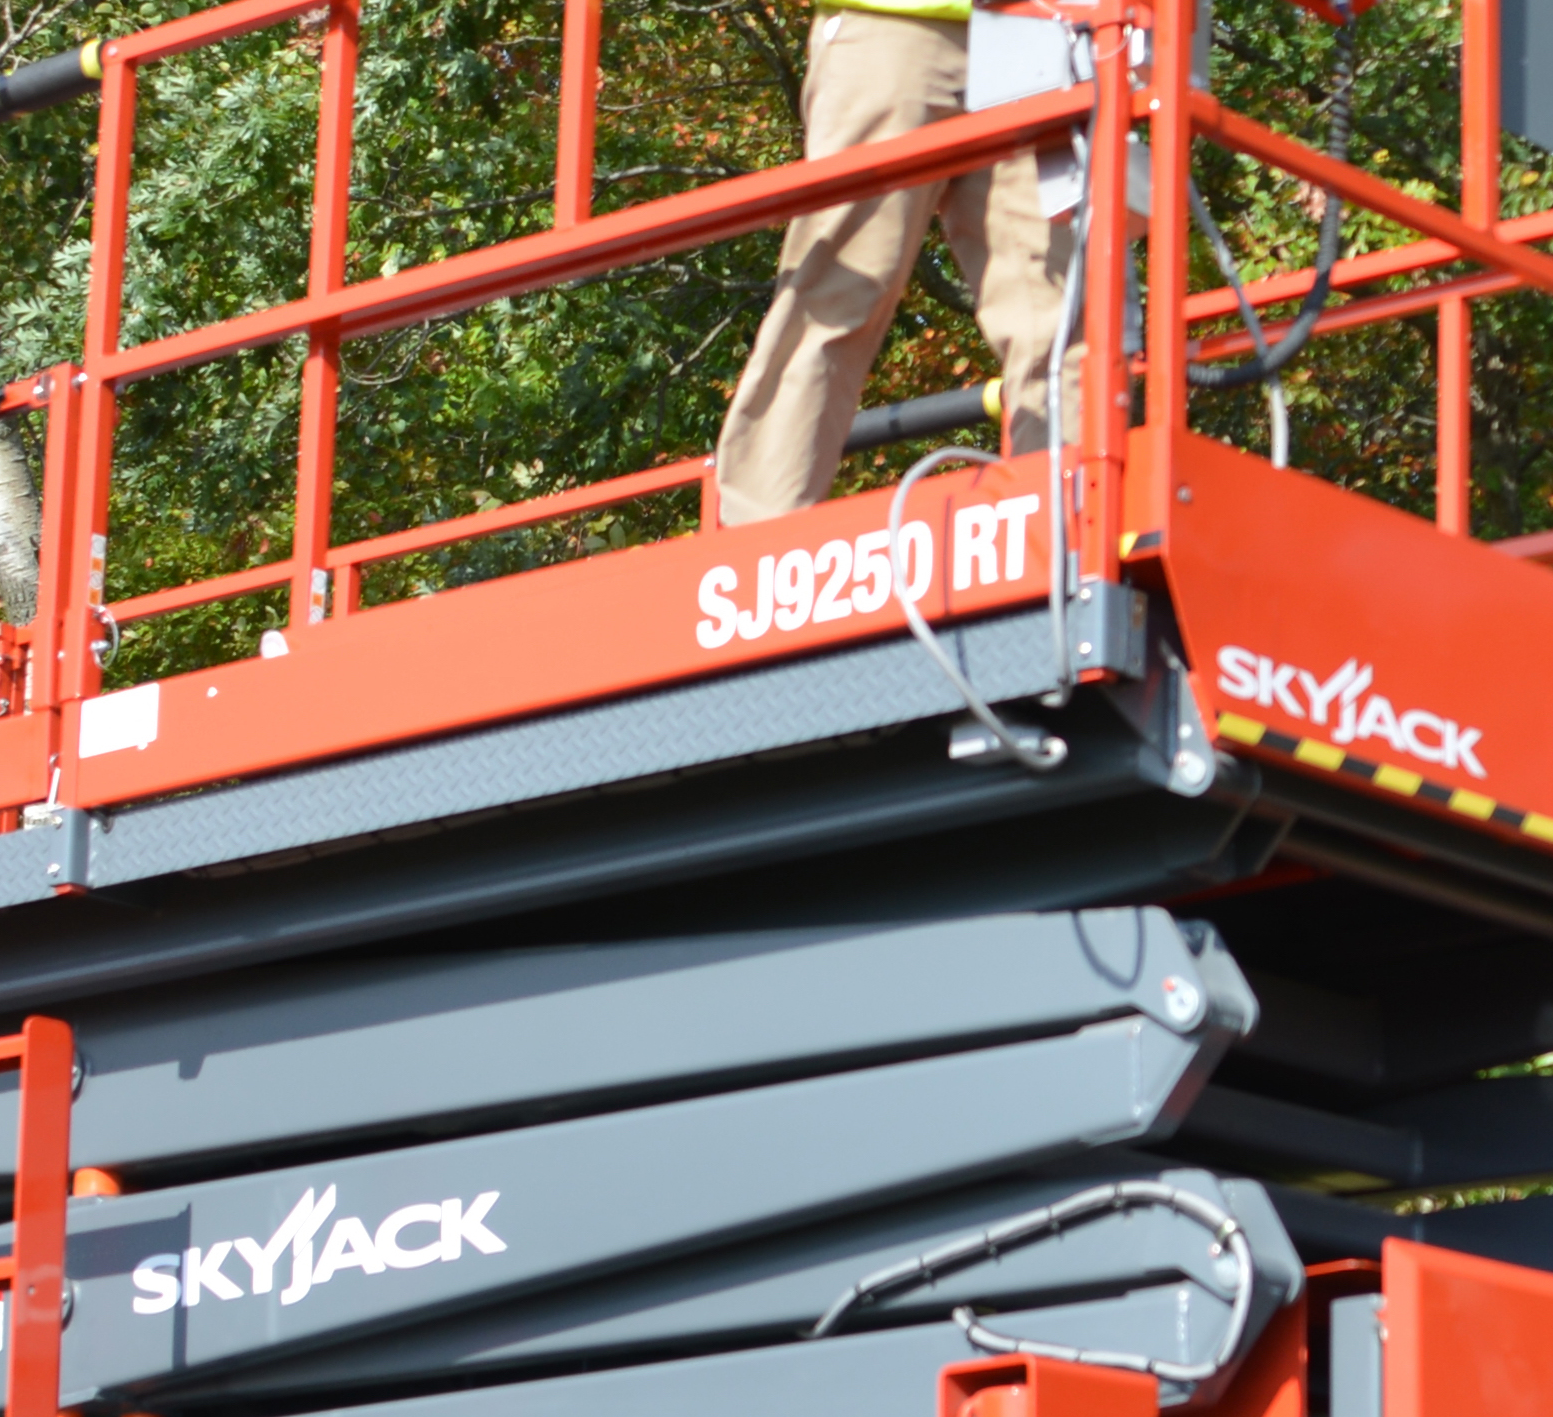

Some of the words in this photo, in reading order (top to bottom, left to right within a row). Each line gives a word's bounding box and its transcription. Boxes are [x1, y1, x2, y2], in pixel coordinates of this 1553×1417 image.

[696, 520, 934, 650] SJ9250
[952, 493, 1040, 591] RT
[1216, 644, 1488, 780] SKYJACK
[132, 1183, 508, 1315] SKYJACK
